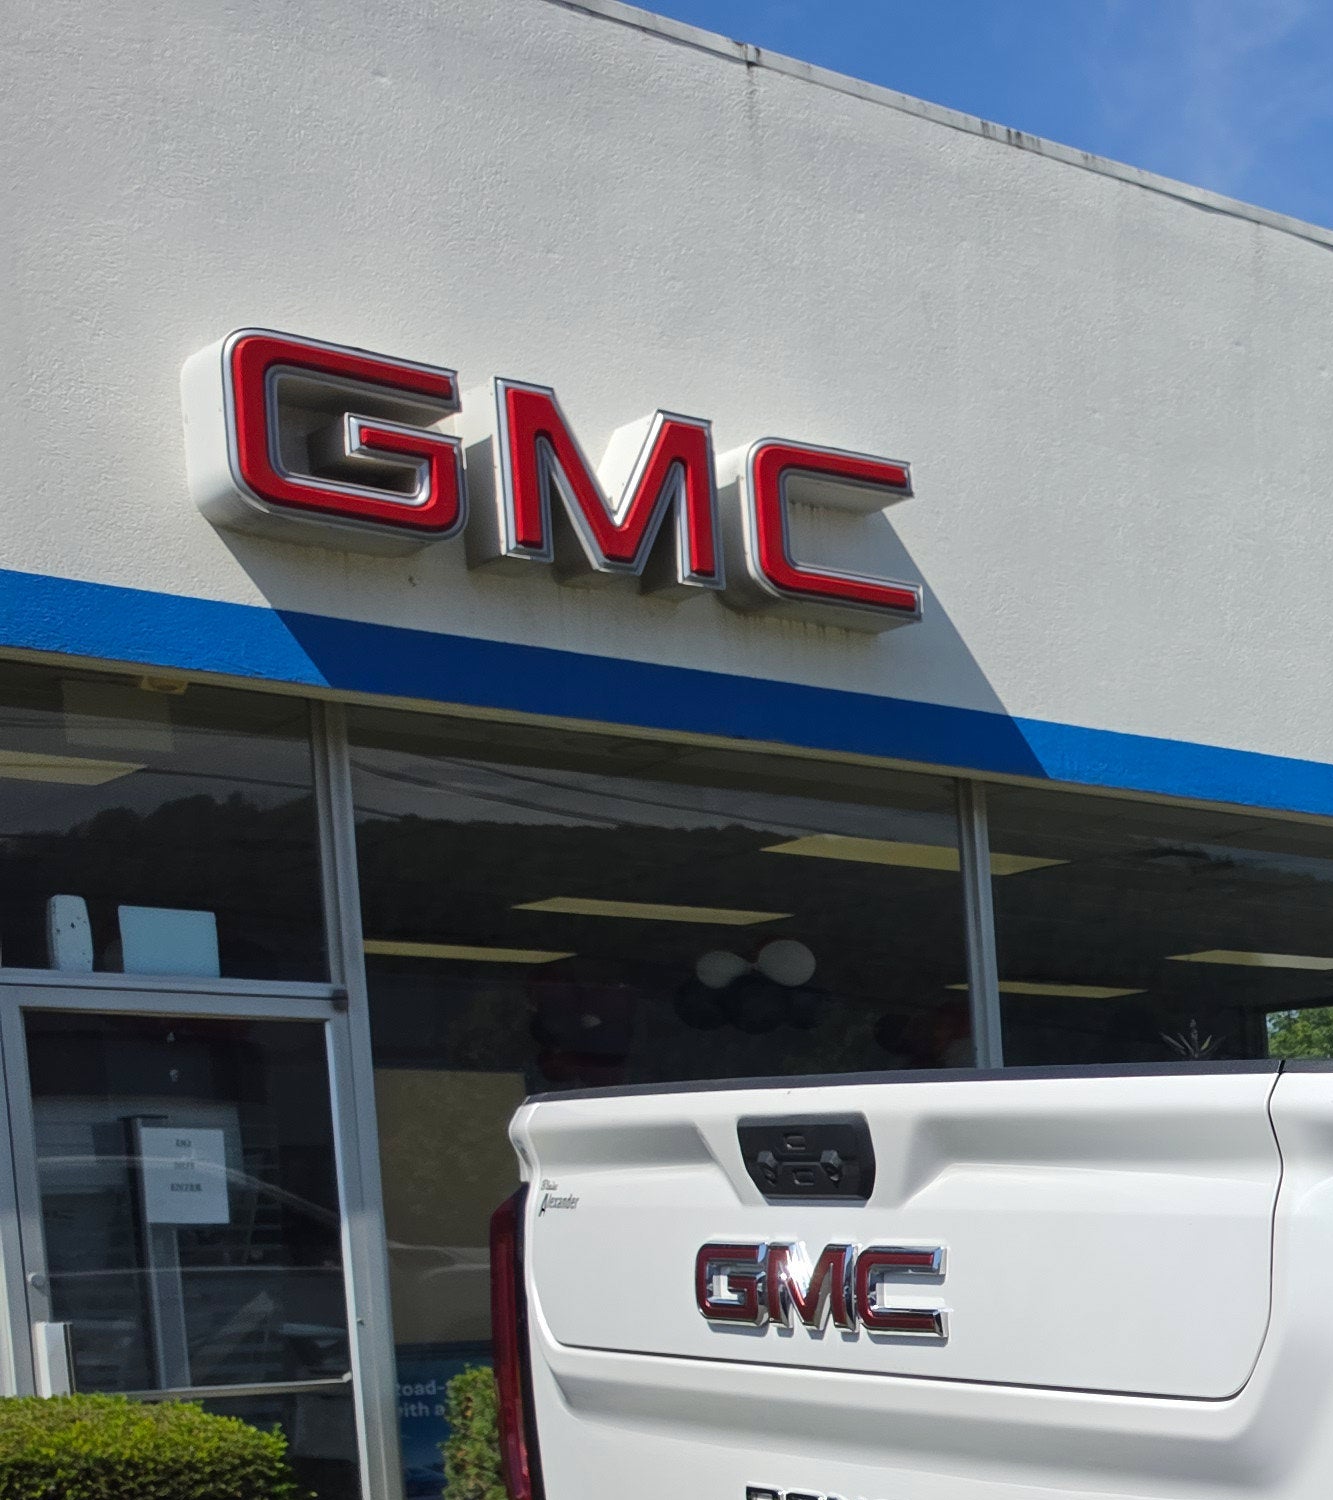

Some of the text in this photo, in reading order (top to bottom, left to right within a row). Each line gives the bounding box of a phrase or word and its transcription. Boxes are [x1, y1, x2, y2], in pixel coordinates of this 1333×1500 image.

[216, 326, 924, 625] GMC
[538, 1192, 580, 1218] Alexander
[694, 1241, 951, 1340] GMC
